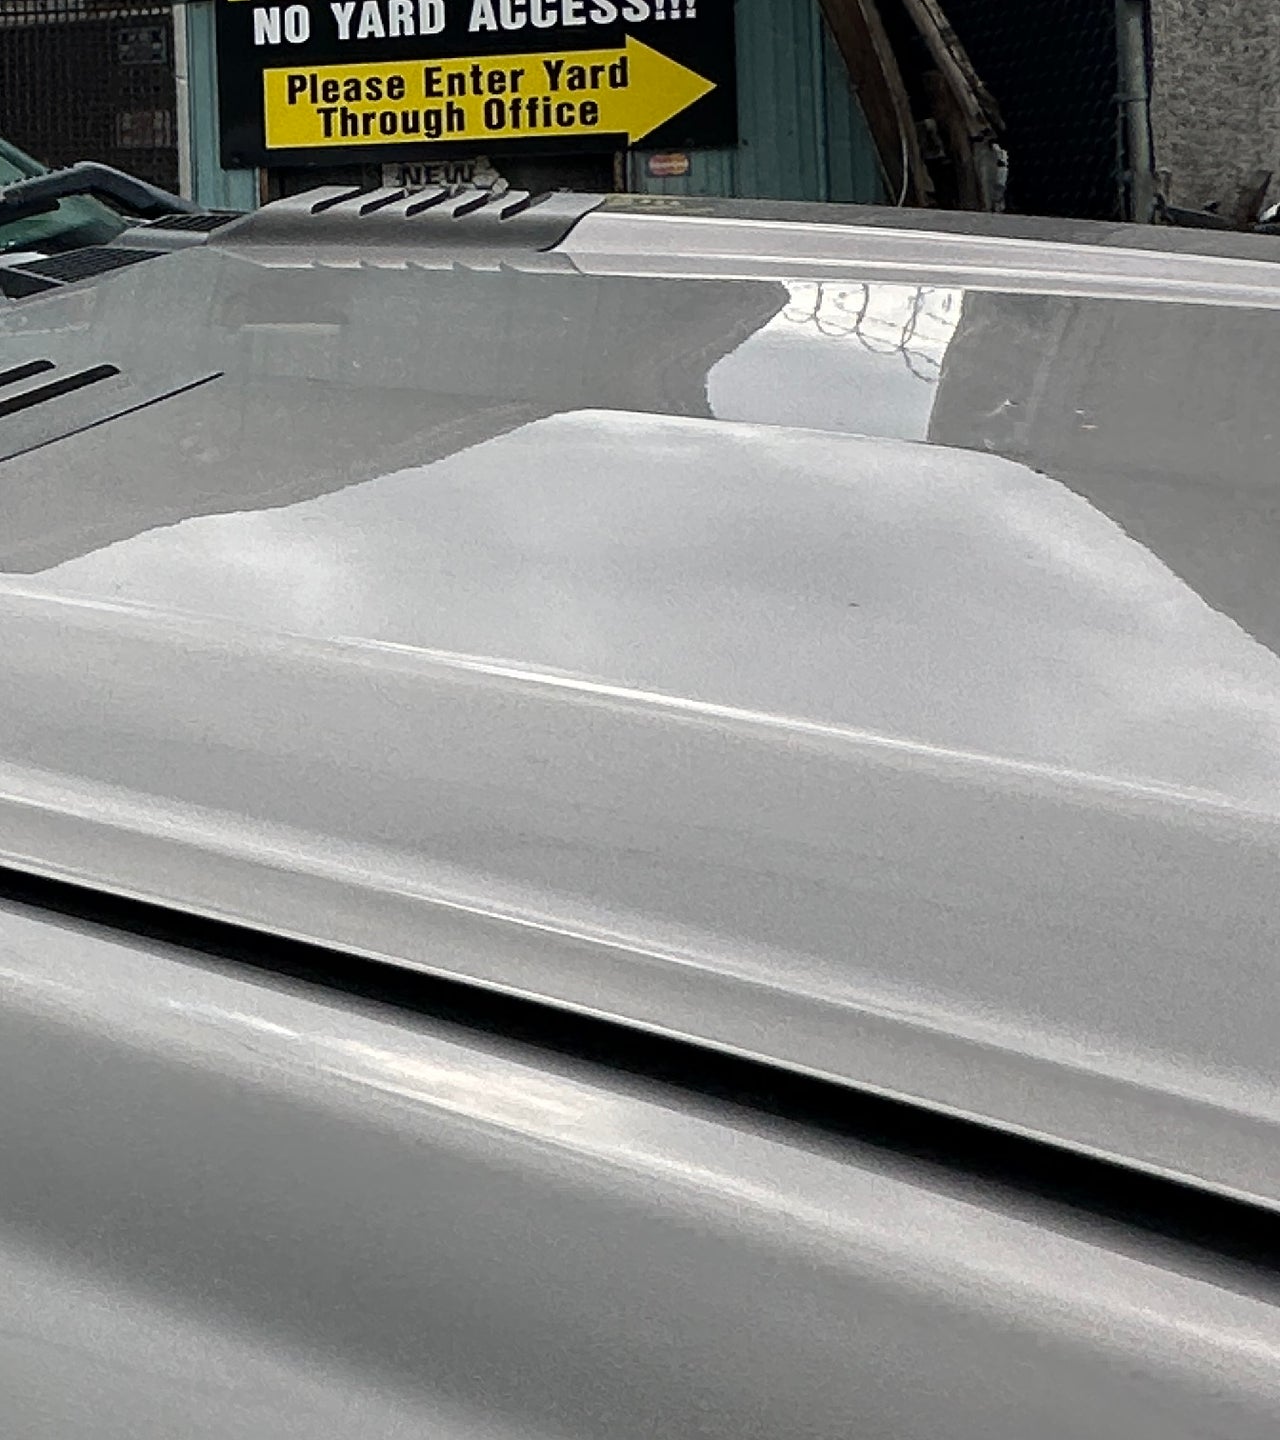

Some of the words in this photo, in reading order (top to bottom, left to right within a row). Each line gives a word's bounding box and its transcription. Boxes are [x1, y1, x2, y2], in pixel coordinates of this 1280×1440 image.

[254, 5, 309, 45] NO
[288, 69, 405, 106] Please
[425, 65, 525, 99] Enter
[543, 57, 629, 91] Yard
[317, 102, 465, 140] Through
[484, 98, 598, 131] Office
